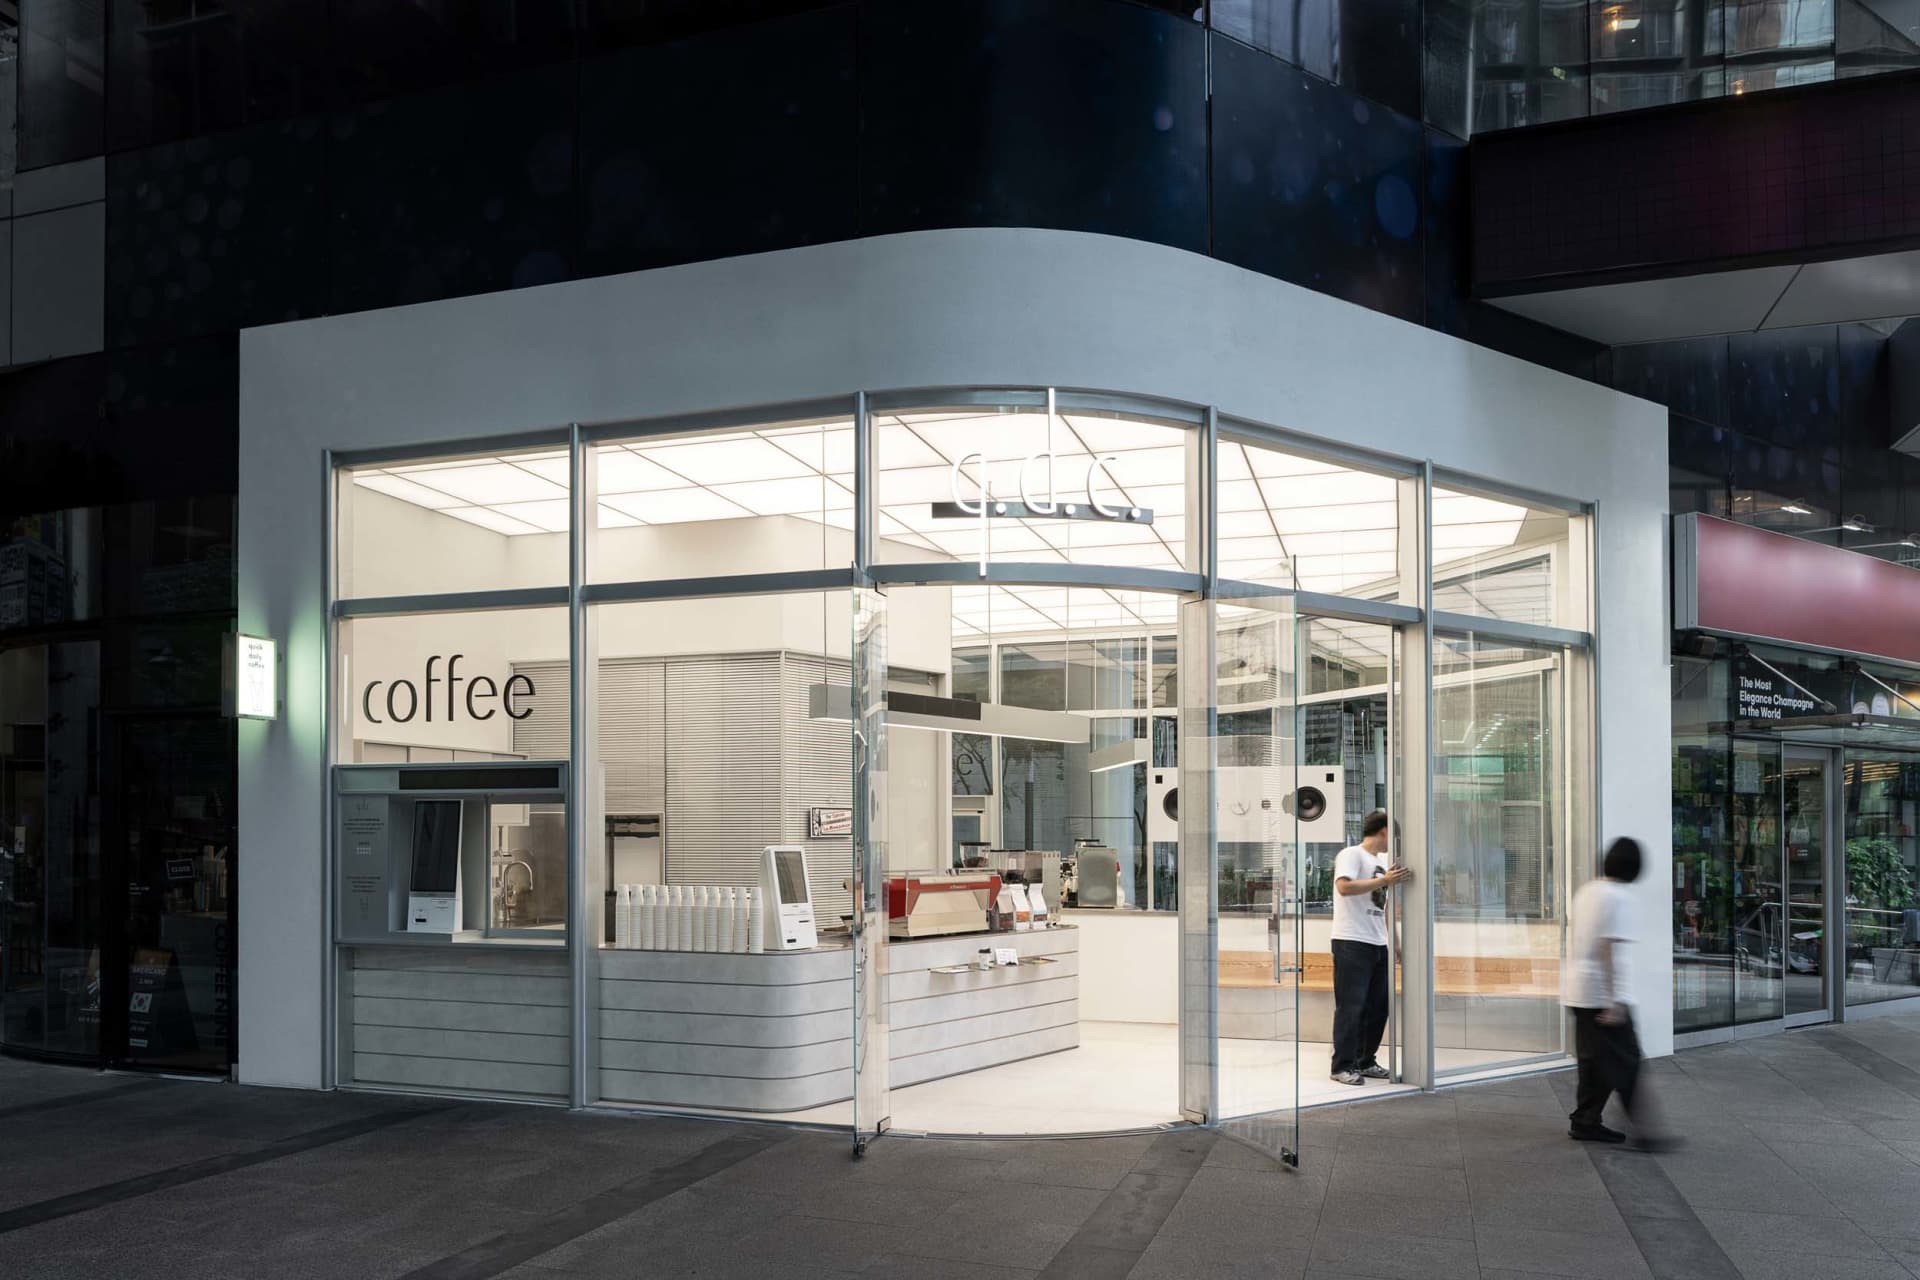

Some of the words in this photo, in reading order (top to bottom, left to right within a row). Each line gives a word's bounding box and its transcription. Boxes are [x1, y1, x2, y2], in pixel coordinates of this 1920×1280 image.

[362, 653, 536, 724] coffee
[1739, 676, 1754, 688] The
[1755, 678, 1772, 690] Most
[1739, 690, 1772, 705] Elegance
[1773, 694, 1814, 711] Champagne
[1739, 704, 1747, 716] in
[1748, 706, 1760, 717] the
[1761, 707, 1781, 719] World
